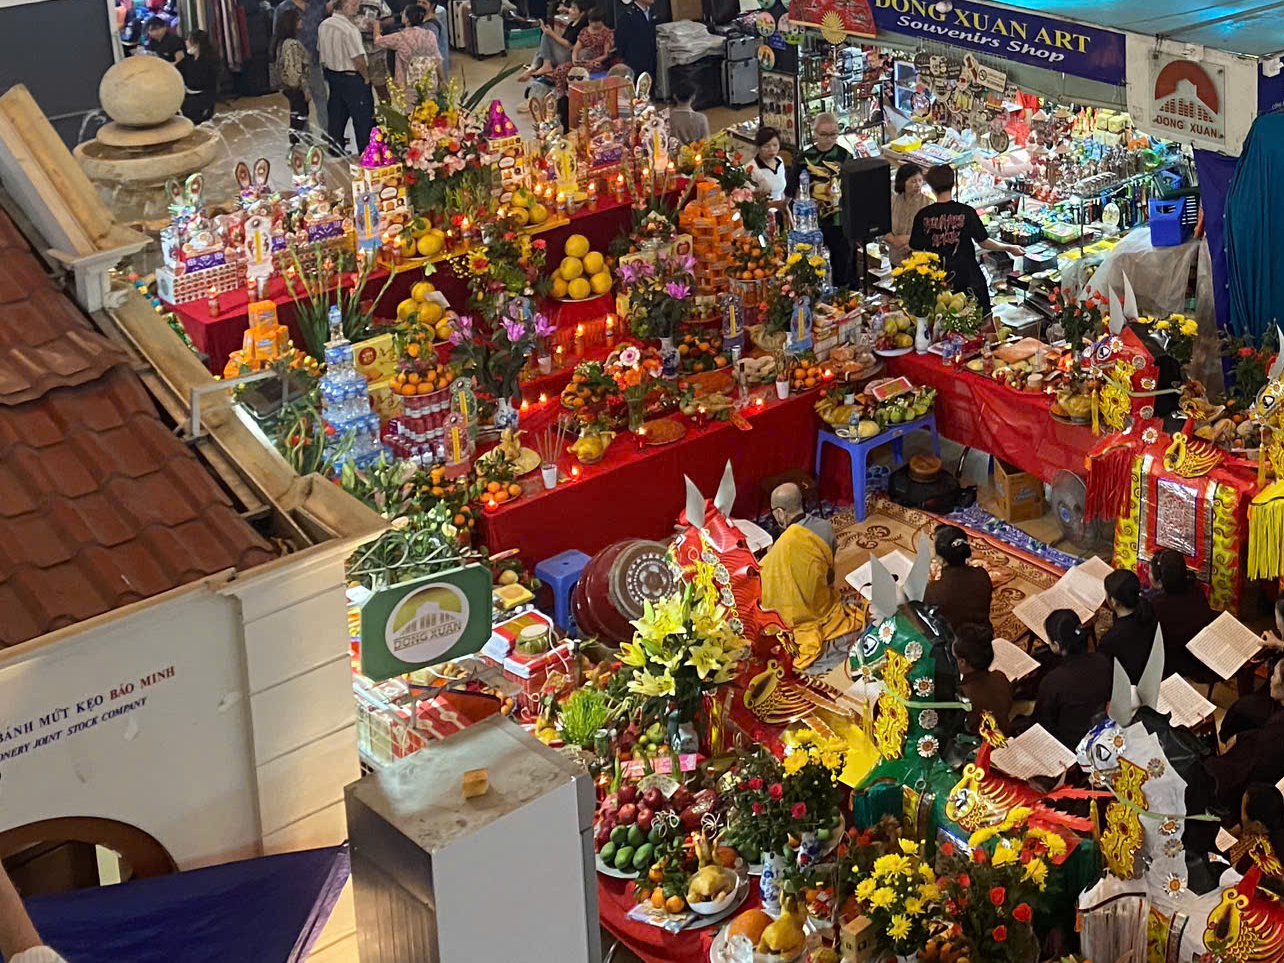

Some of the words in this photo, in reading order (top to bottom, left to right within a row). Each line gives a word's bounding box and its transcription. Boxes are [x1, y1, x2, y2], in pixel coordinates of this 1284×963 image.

[896, 15, 1000, 48] Souvenirs
[1006, 39, 1065, 62] Shop
[954, 7, 1028, 40] XUAN
[1035, 27, 1091, 54] ART
[1155, 114, 1184, 130] DONG
[1190, 122, 1218, 138] XUAN
[394, 632, 428, 649] DONG
[429, 622, 462, 637] XUAN
[39, 707, 70, 728] MỨT
[76, 694, 104, 716] KẸO
[110, 683, 135, 701] BẢO
[140, 665, 176, 689] MINH
[32, 731, 63, 750] JOINT
[66, 717, 98, 737] STOCK
[101, 696, 148, 723] COMPANY
